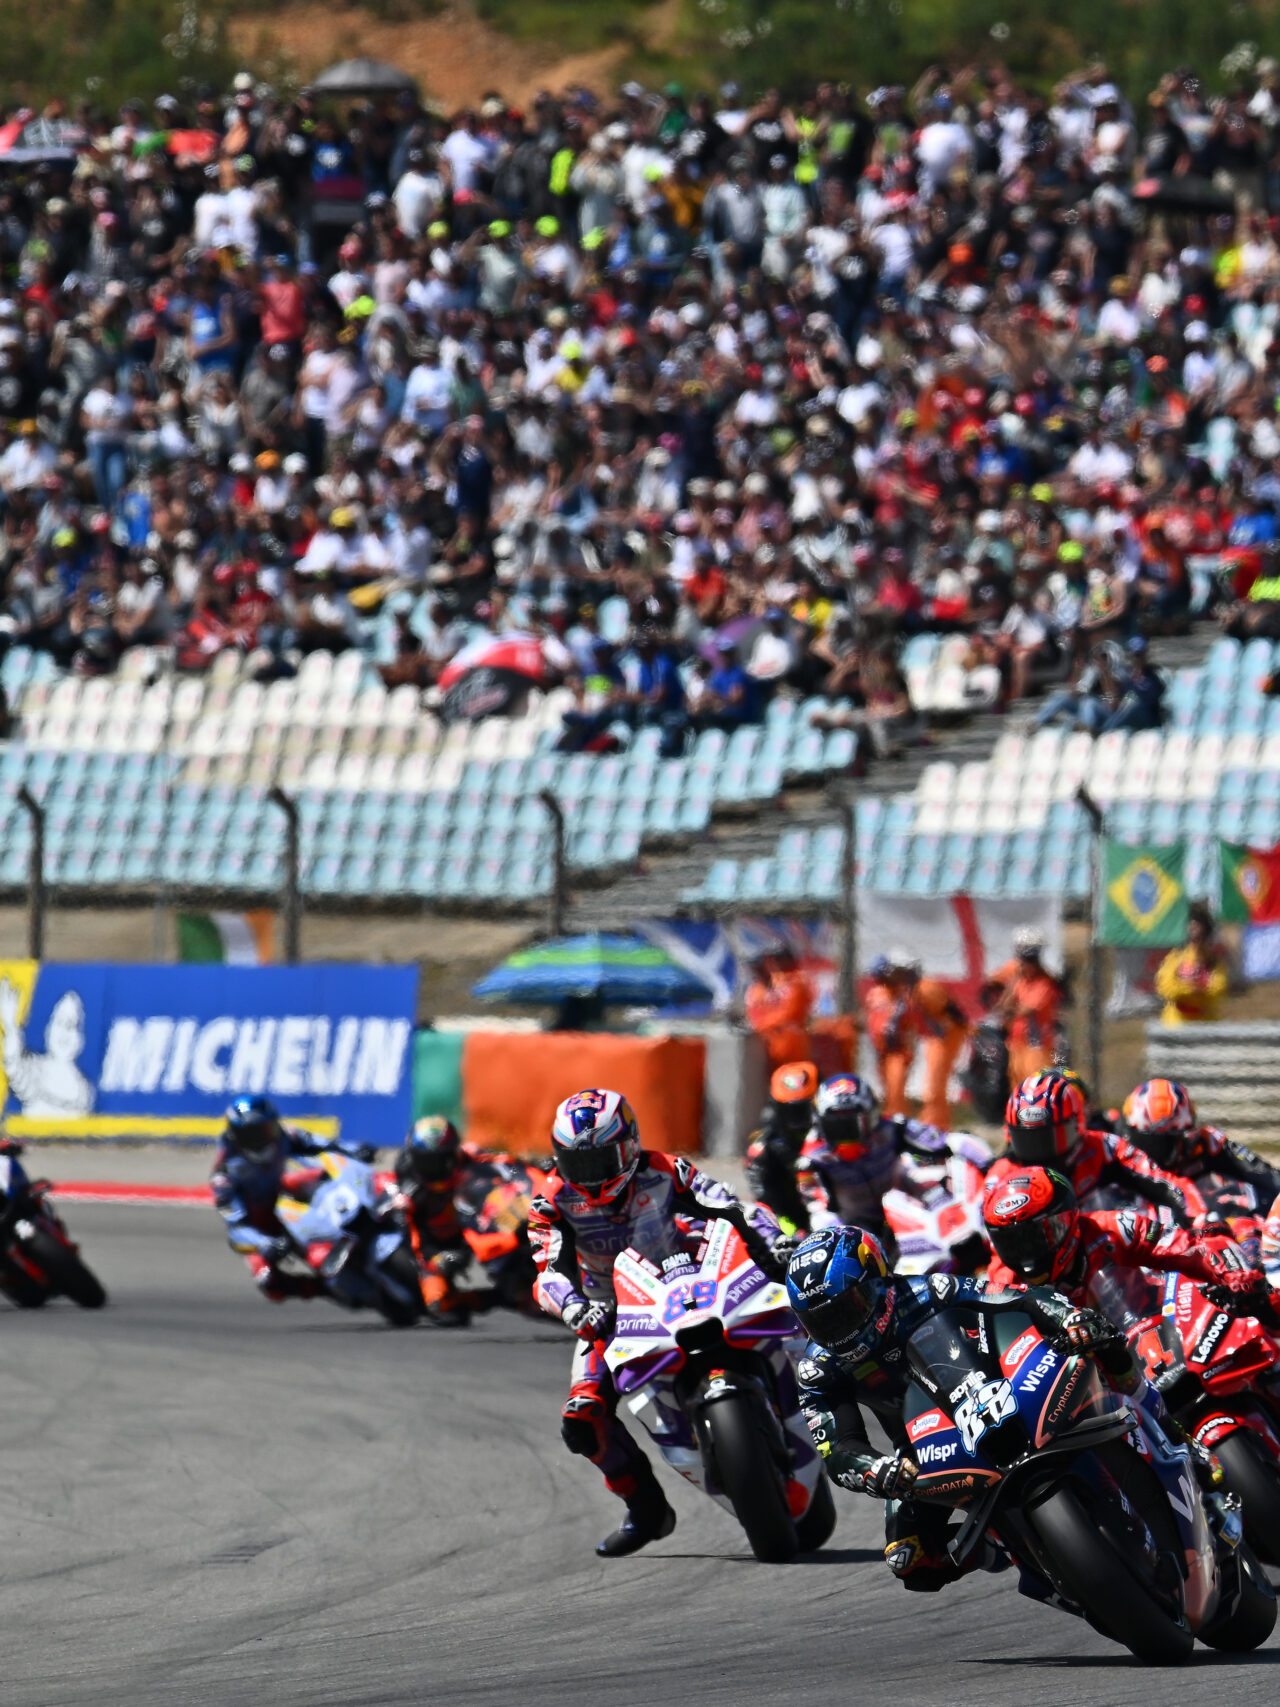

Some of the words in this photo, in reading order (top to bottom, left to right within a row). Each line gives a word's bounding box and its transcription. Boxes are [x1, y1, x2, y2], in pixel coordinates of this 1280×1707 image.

[101, 1016, 411, 1095] MICHELIN
[662, 1280, 718, 1324] 89
[727, 1270, 766, 1304] prima
[797, 1280, 832, 1300] SHARK
[616, 1318, 659, 1334] prima
[1191, 1313, 1228, 1363] Lenovo
[949, 1371, 986, 1403] aprilia
[1019, 1348, 1059, 1392] Wispr
[1048, 1364, 1086, 1423] CryptoDATA
[1196, 1416, 1235, 1441] enovo
[917, 1442, 957, 1464] Wispr
